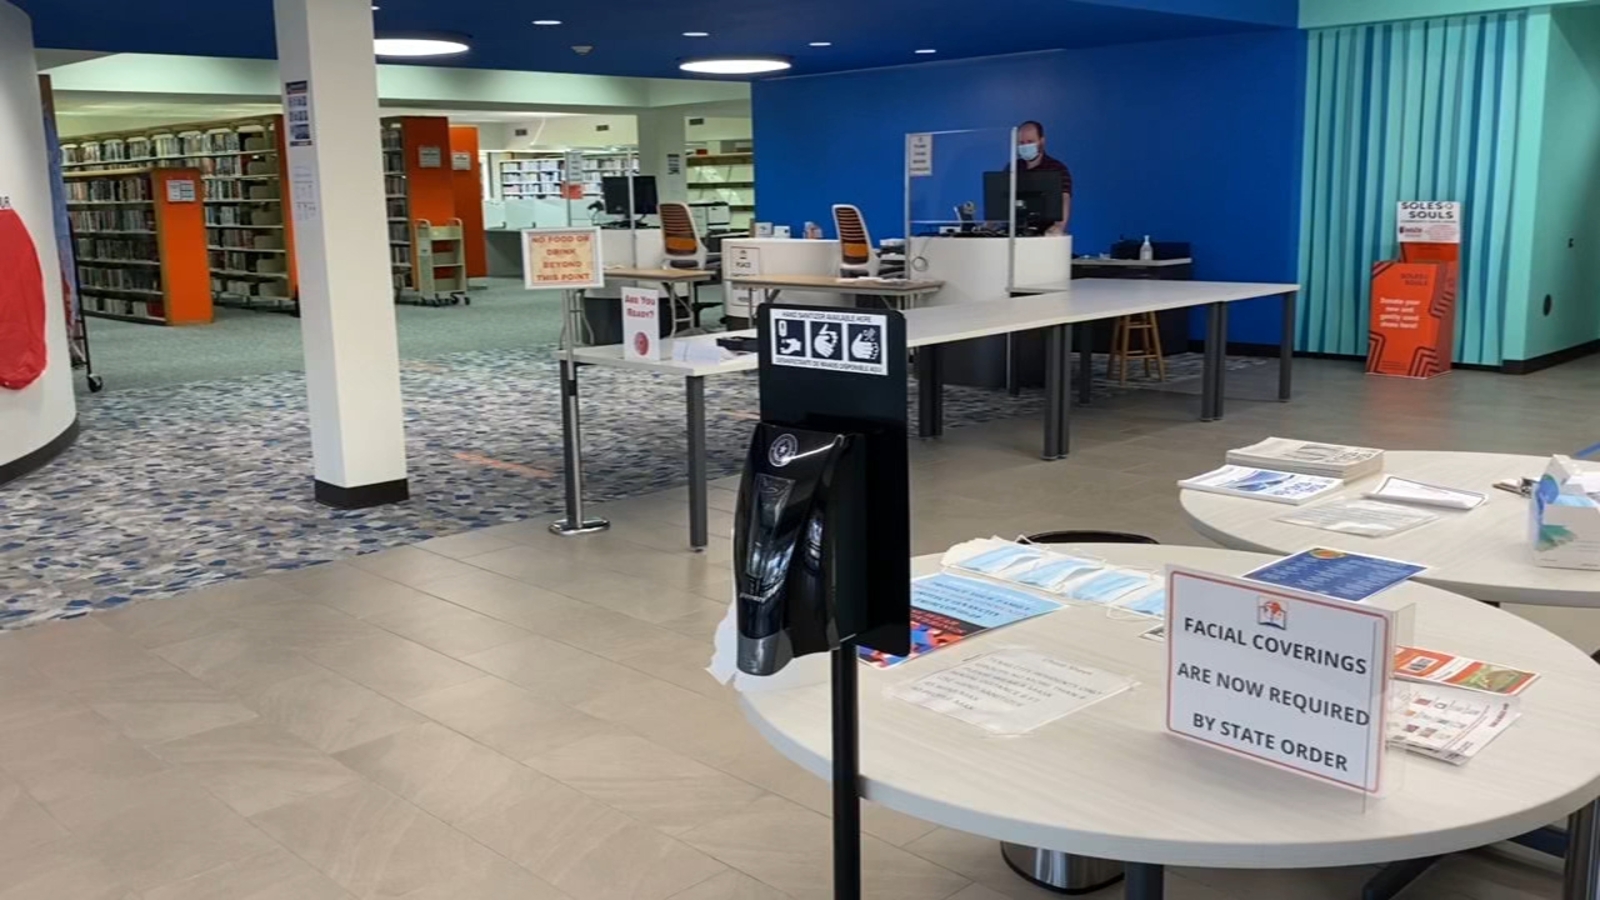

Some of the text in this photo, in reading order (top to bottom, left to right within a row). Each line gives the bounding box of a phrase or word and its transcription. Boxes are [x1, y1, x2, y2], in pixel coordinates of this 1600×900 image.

[1408, 211, 1454, 219] SOULS
[548, 235, 574, 243] FOOD
[546, 248, 576, 256] DRINK
[543, 261, 582, 269] BEYOND
[1184, 616, 1368, 675] FACIAL COVERINGS
[1176, 662, 1370, 726] ARE NOW REQUIRED
[1193, 712, 1348, 772] BY STATE ORDER
